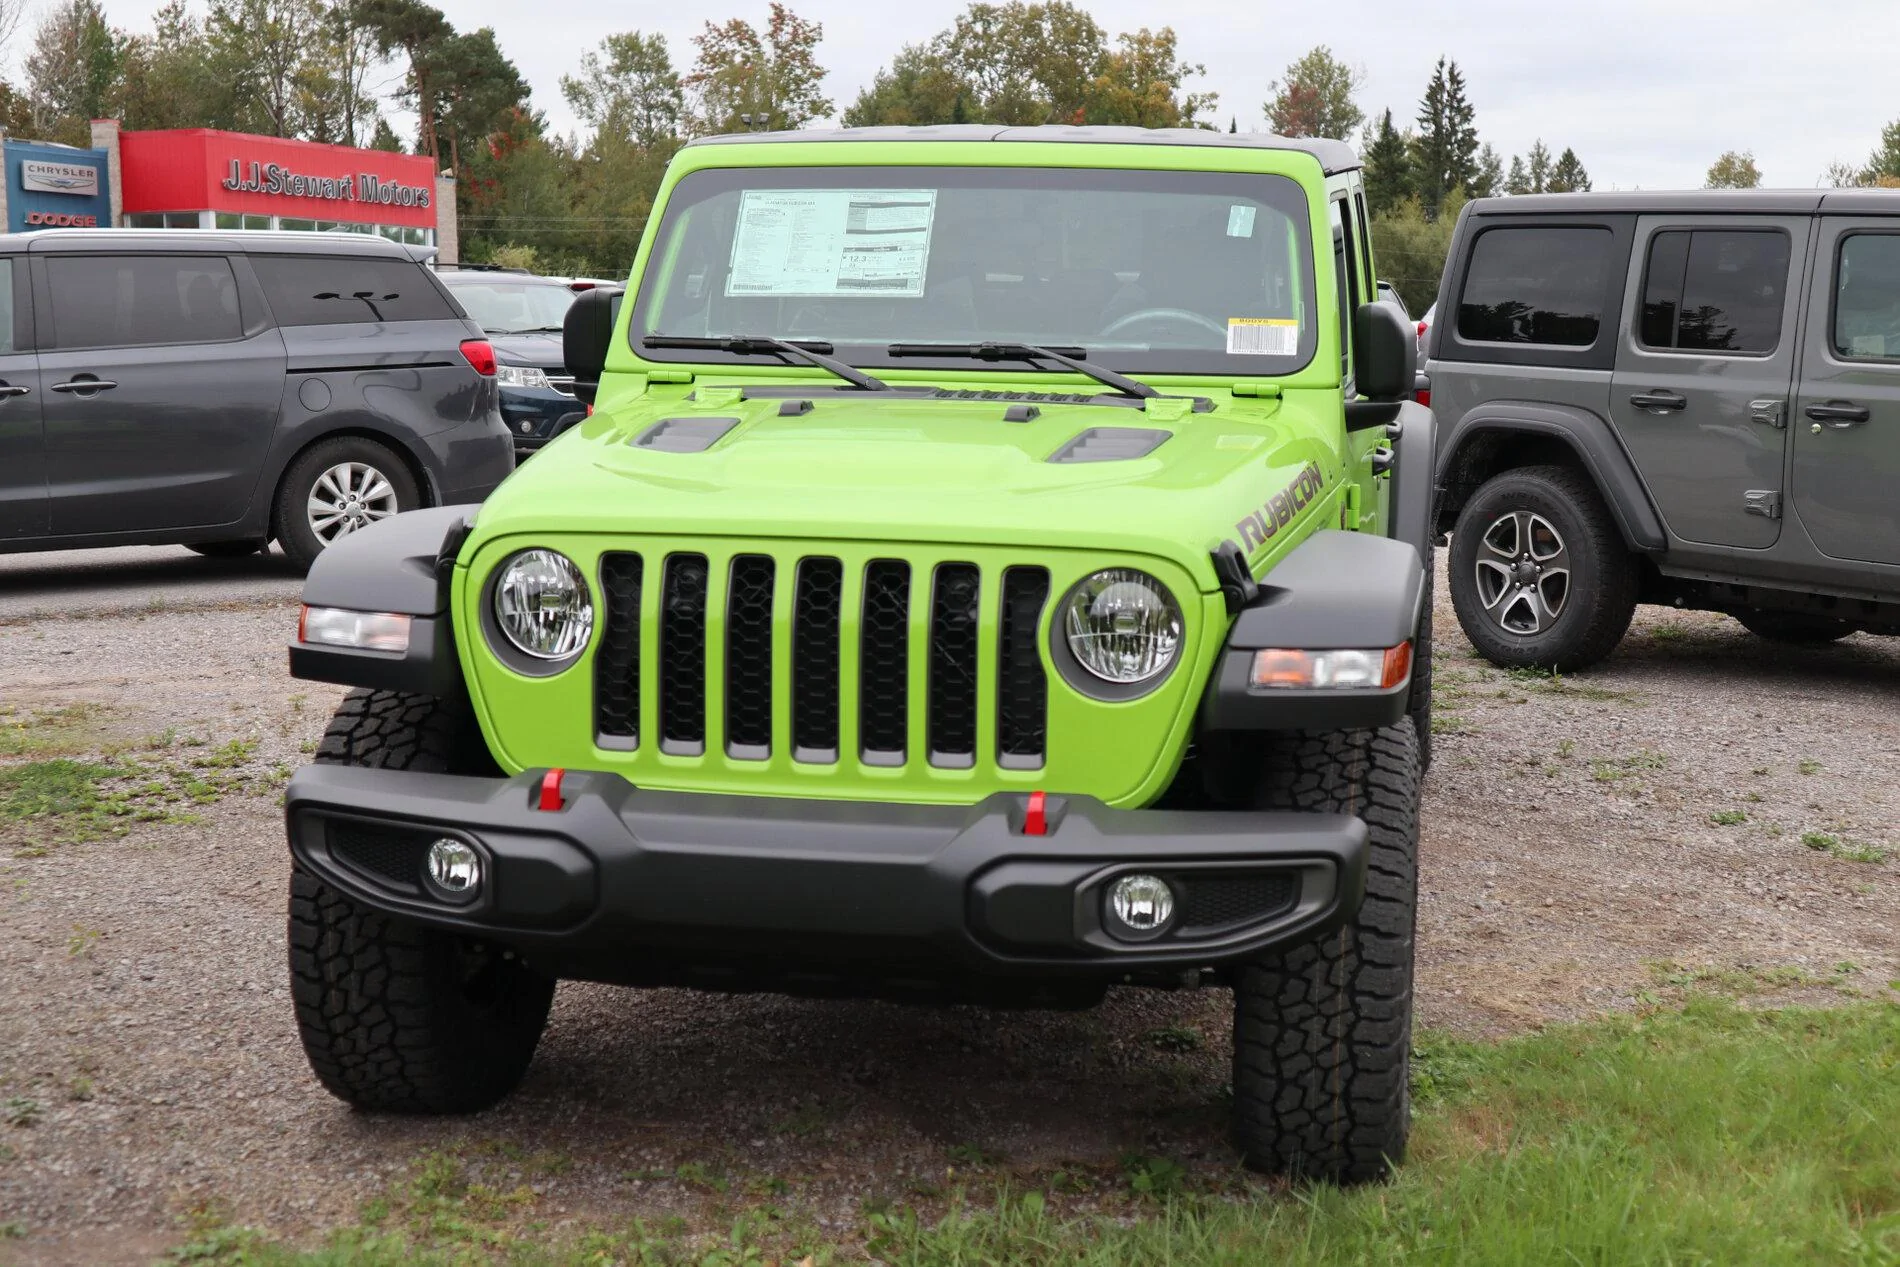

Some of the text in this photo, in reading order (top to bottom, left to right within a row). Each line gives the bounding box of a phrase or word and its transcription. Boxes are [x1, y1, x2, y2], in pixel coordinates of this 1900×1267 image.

[28, 164, 94, 177] CHRYSLER
[357, 173, 430, 208] Motors
[27, 211, 97, 227] DODGE
[1235, 460, 1324, 554] RUBICON
